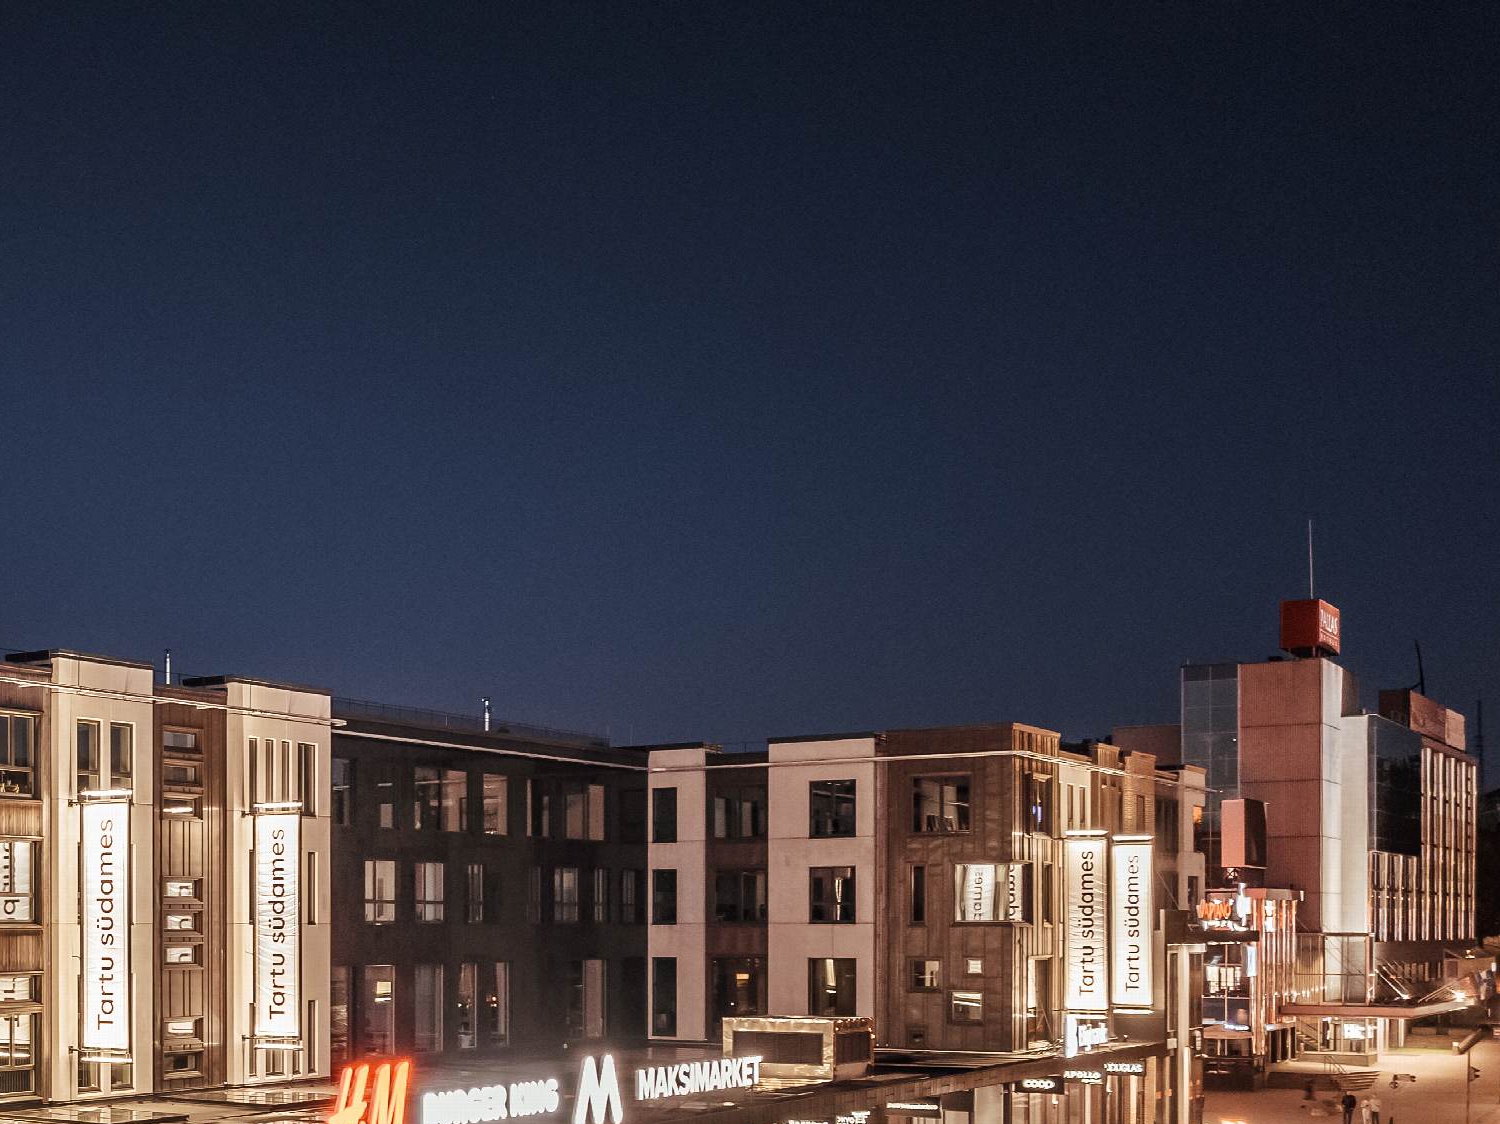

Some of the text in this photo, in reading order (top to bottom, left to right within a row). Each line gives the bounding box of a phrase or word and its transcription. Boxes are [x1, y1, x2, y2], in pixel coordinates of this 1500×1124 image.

[96, 818, 115, 1031] Tartu südames
[267, 828, 286, 1020] Tartu südames
[1078, 850, 1095, 996] Tartu südames
[1124, 855, 1140, 992] Tartu südames
[636, 1056, 764, 1101] MAKSIMARKET
[1063, 1070, 1101, 1080] APOLLO
